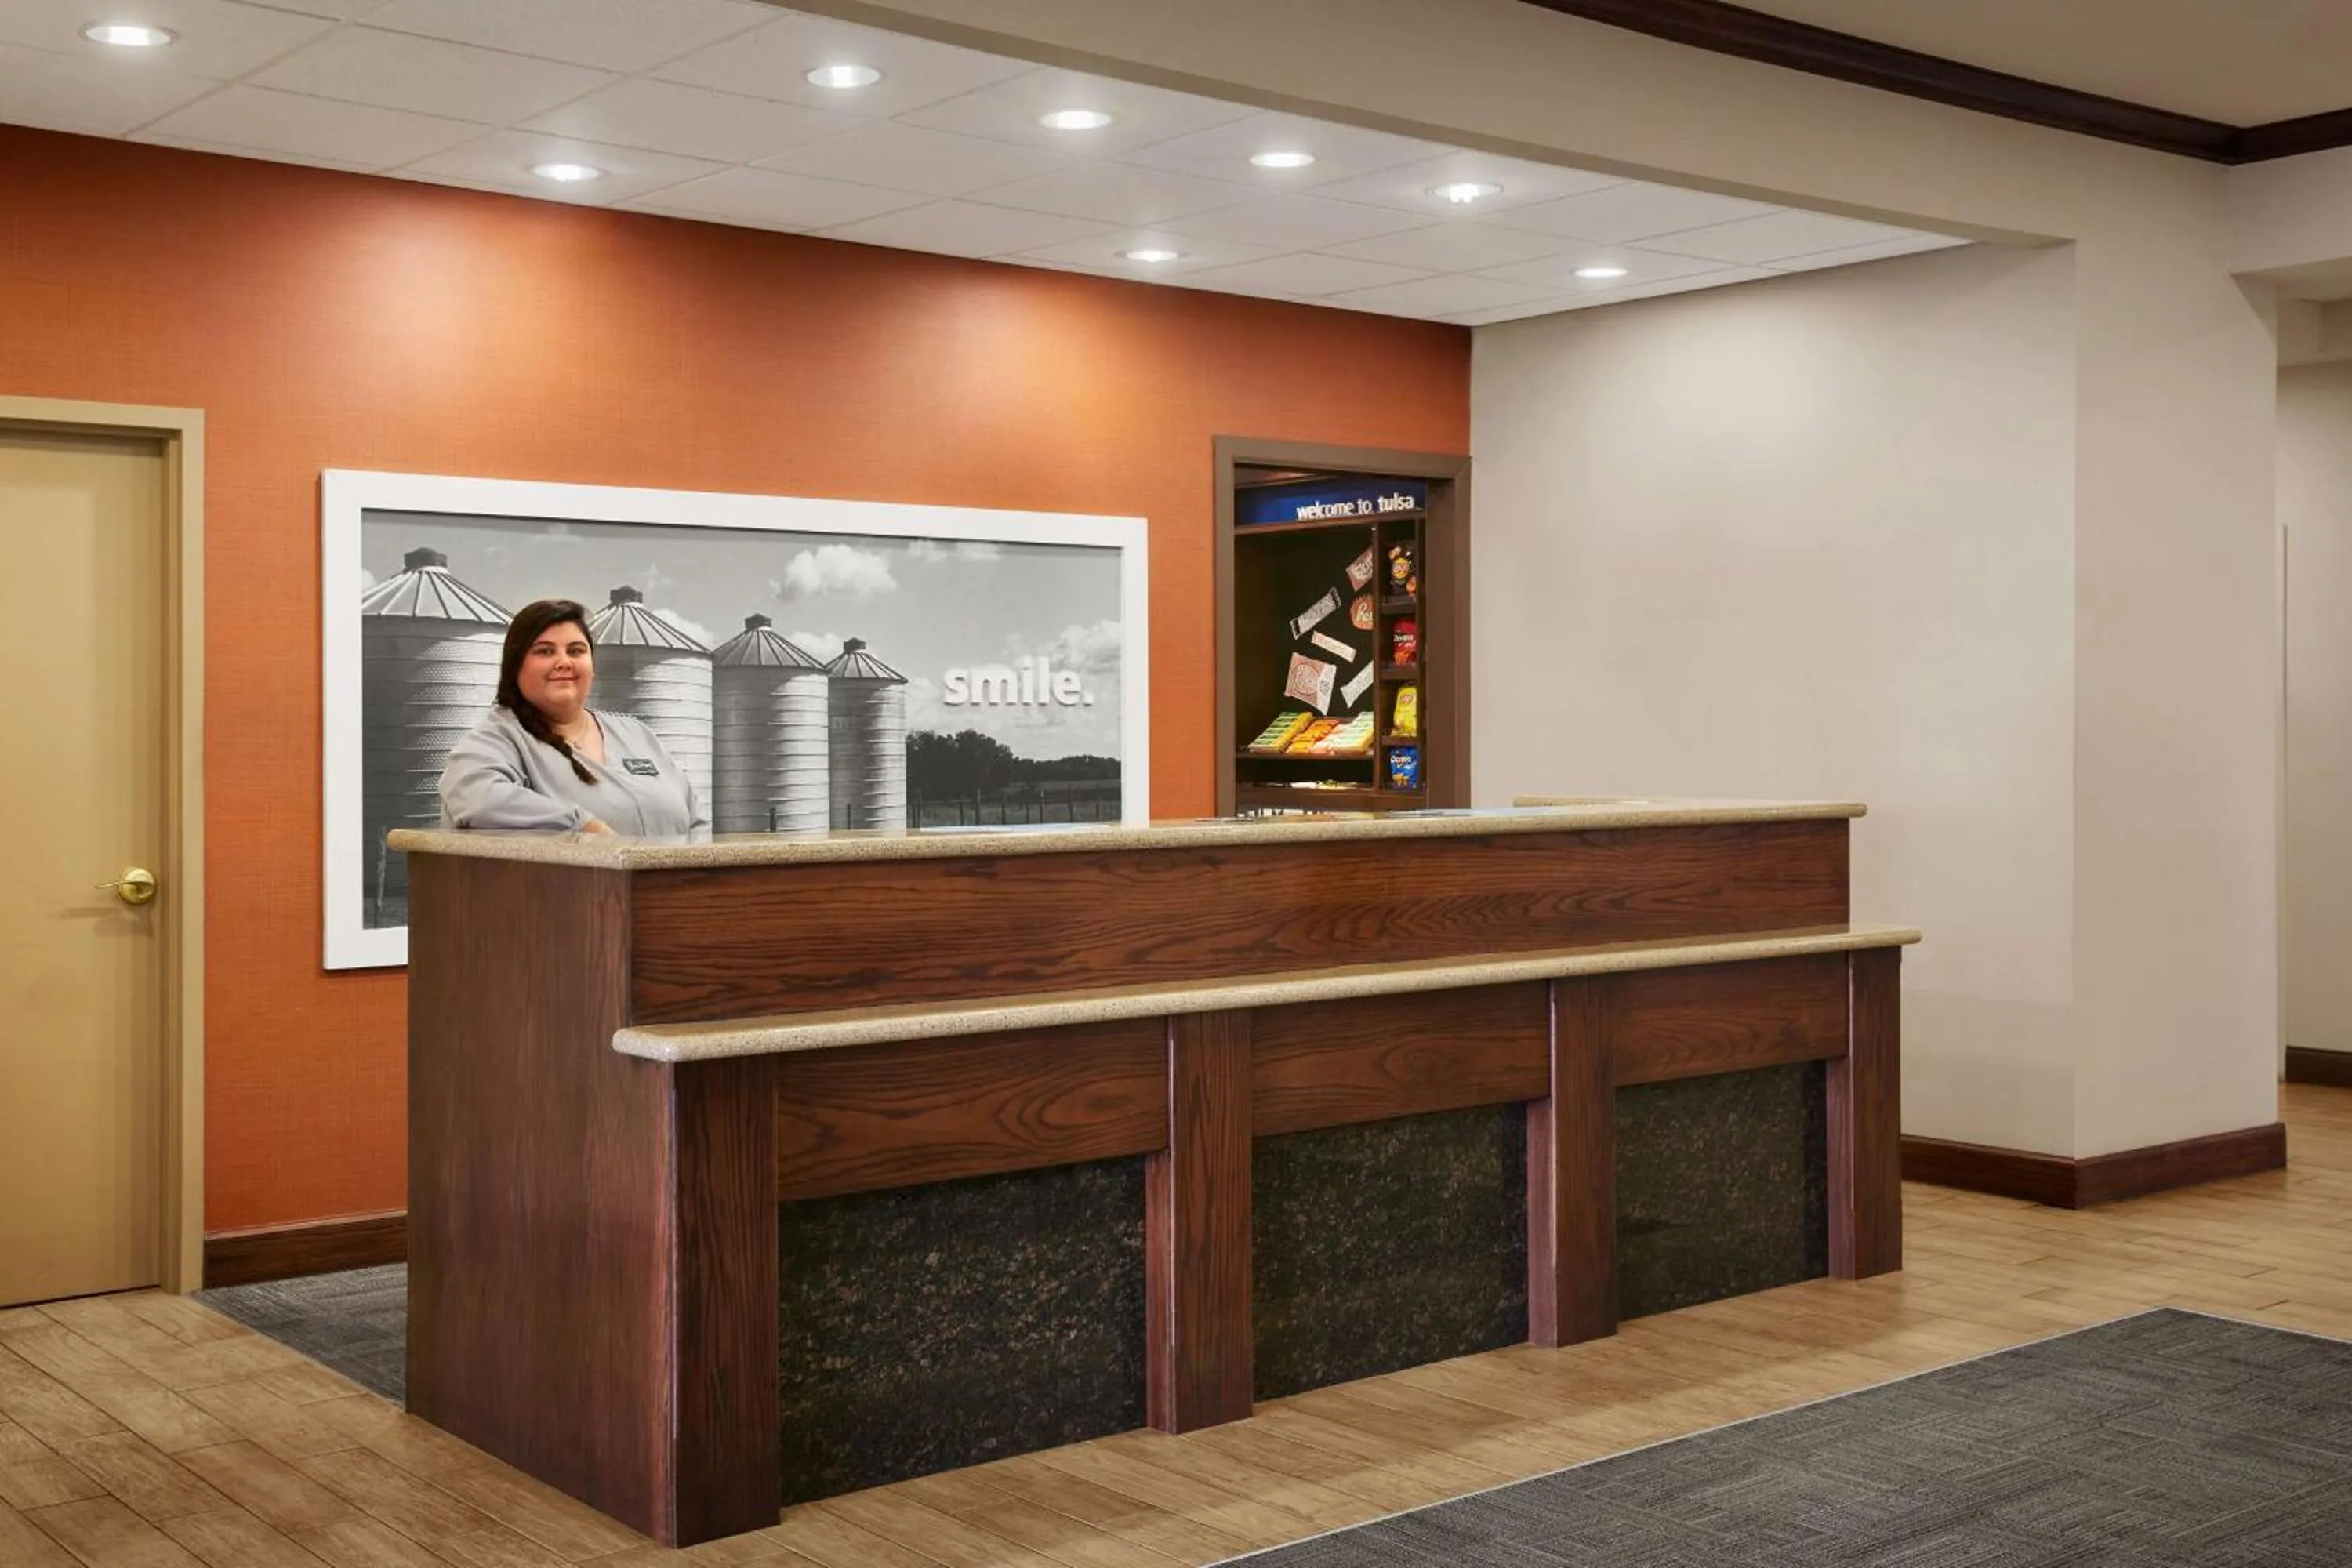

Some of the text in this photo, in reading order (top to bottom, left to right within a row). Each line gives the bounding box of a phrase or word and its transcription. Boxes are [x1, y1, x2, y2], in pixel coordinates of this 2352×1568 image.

[1296, 492, 1414, 521] welcome to tulsa
[943, 655, 1094, 706] smile.
